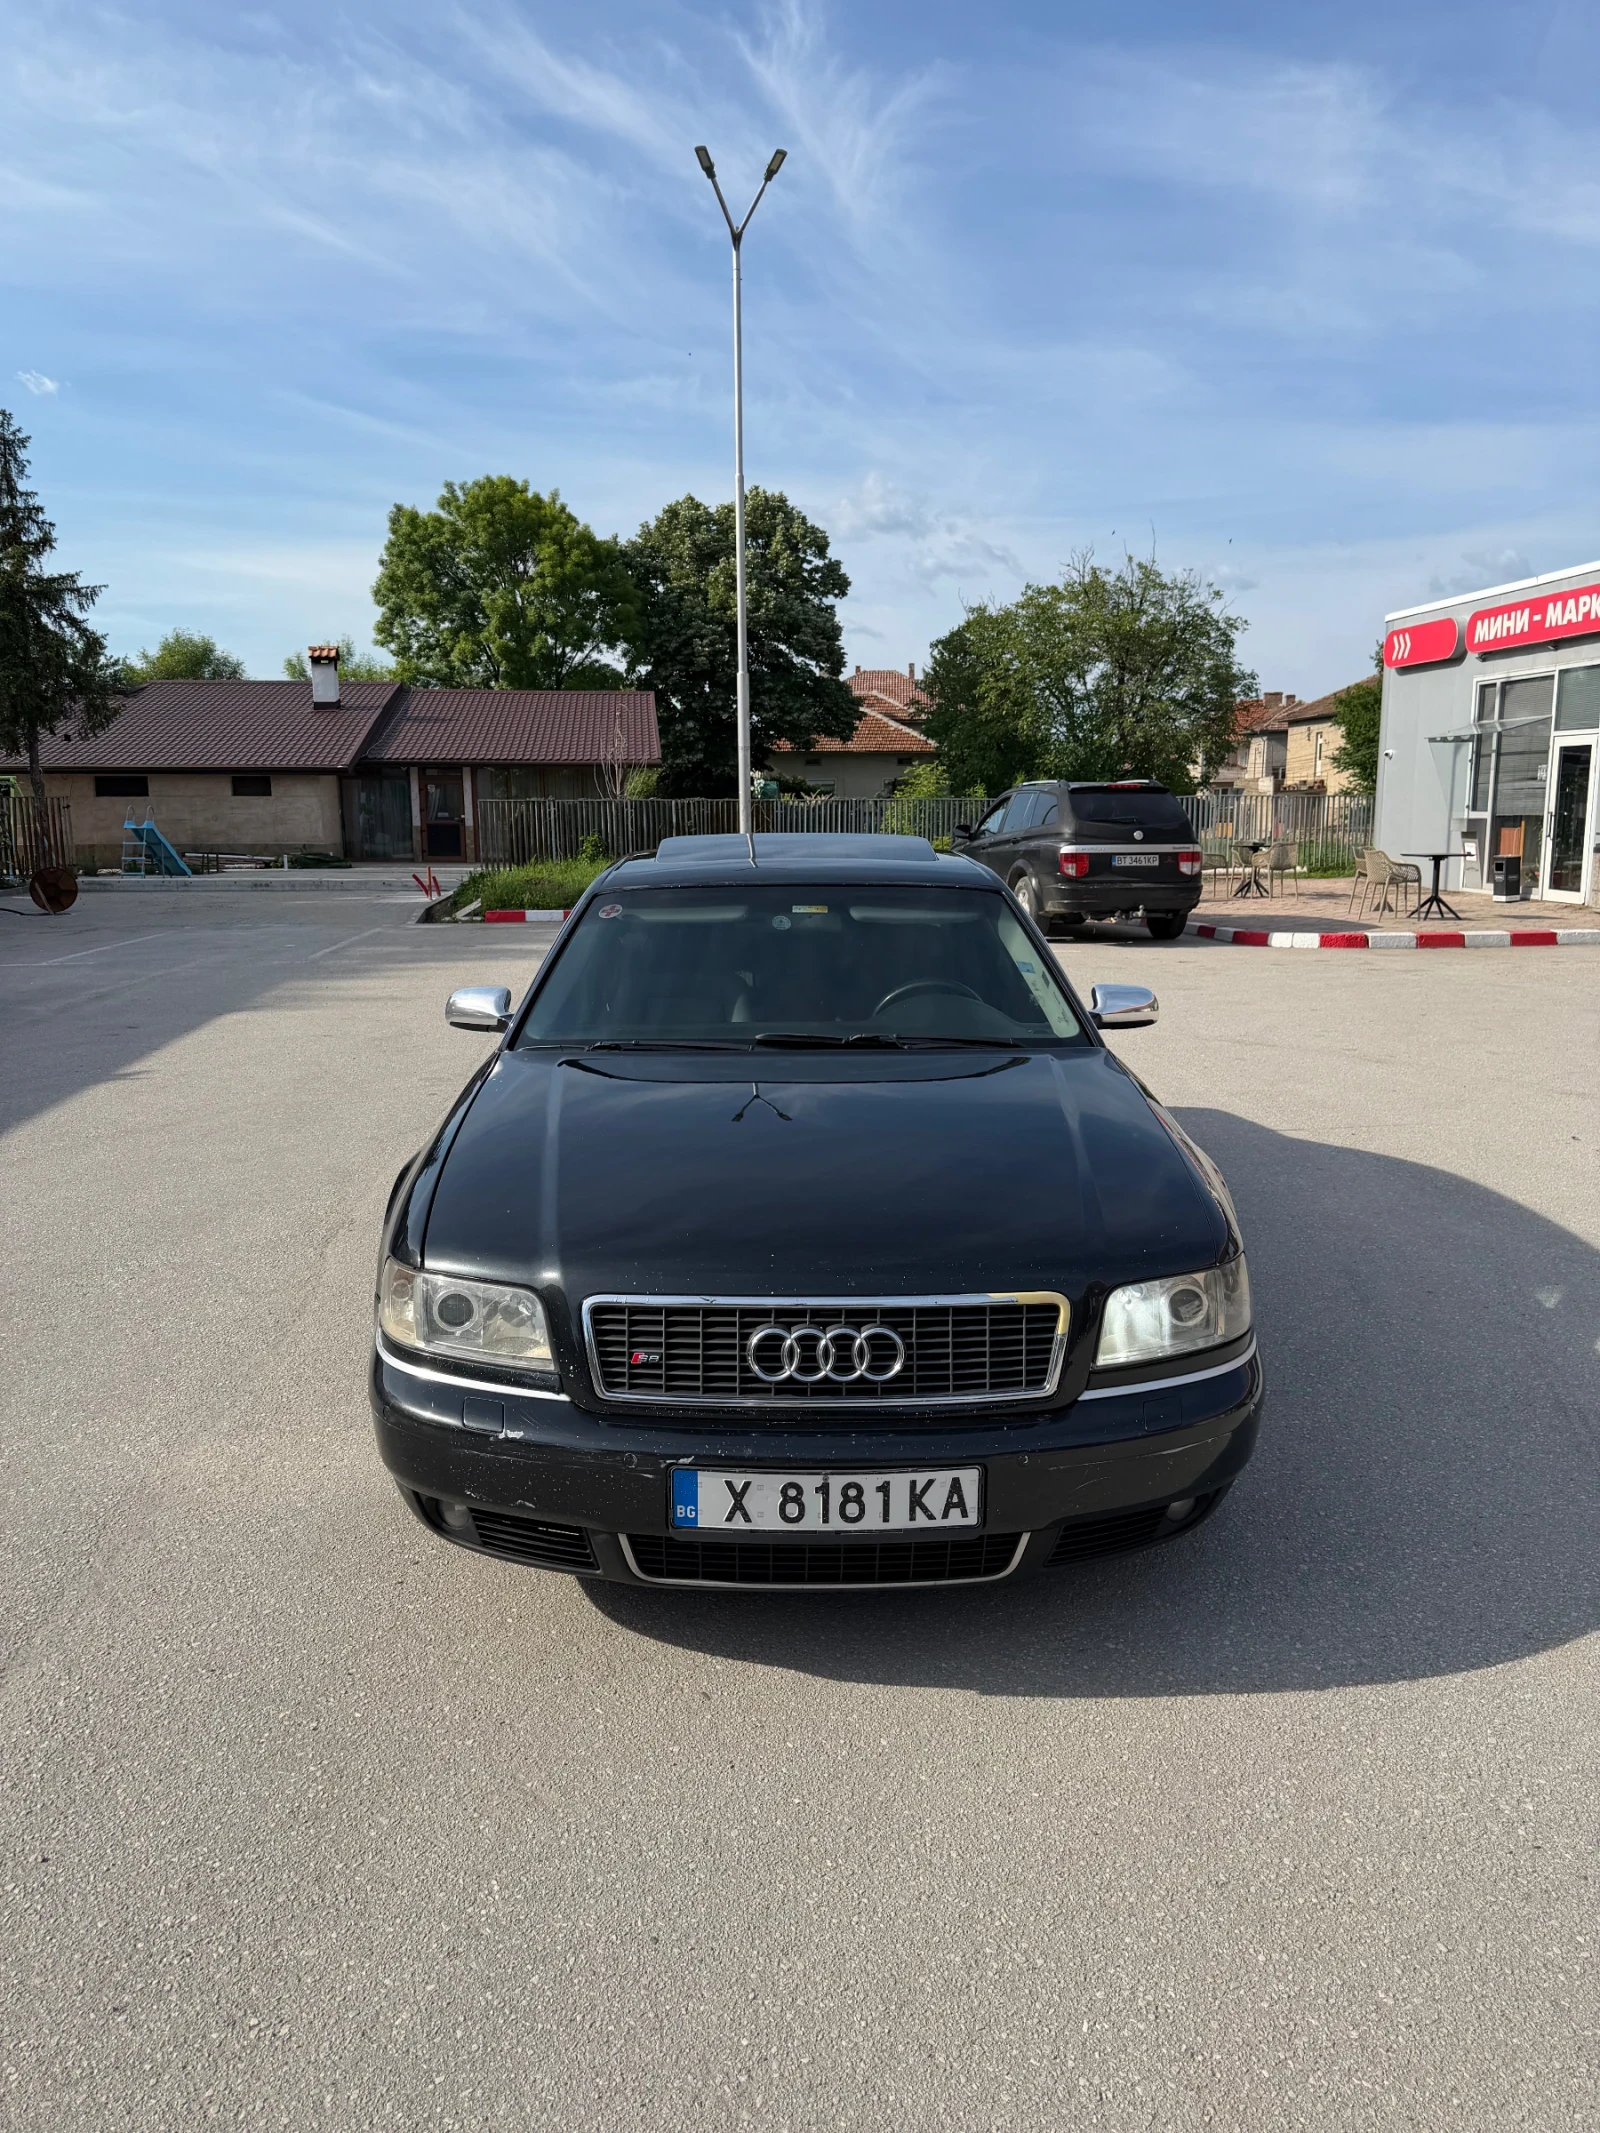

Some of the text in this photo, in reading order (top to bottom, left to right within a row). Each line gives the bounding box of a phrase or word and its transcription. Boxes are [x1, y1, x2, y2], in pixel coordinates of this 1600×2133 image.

[1474, 608, 1530, 644] МИНИ
[1545, 593, 1600, 628] МАРК
[676, 1504, 696, 1519] BG
